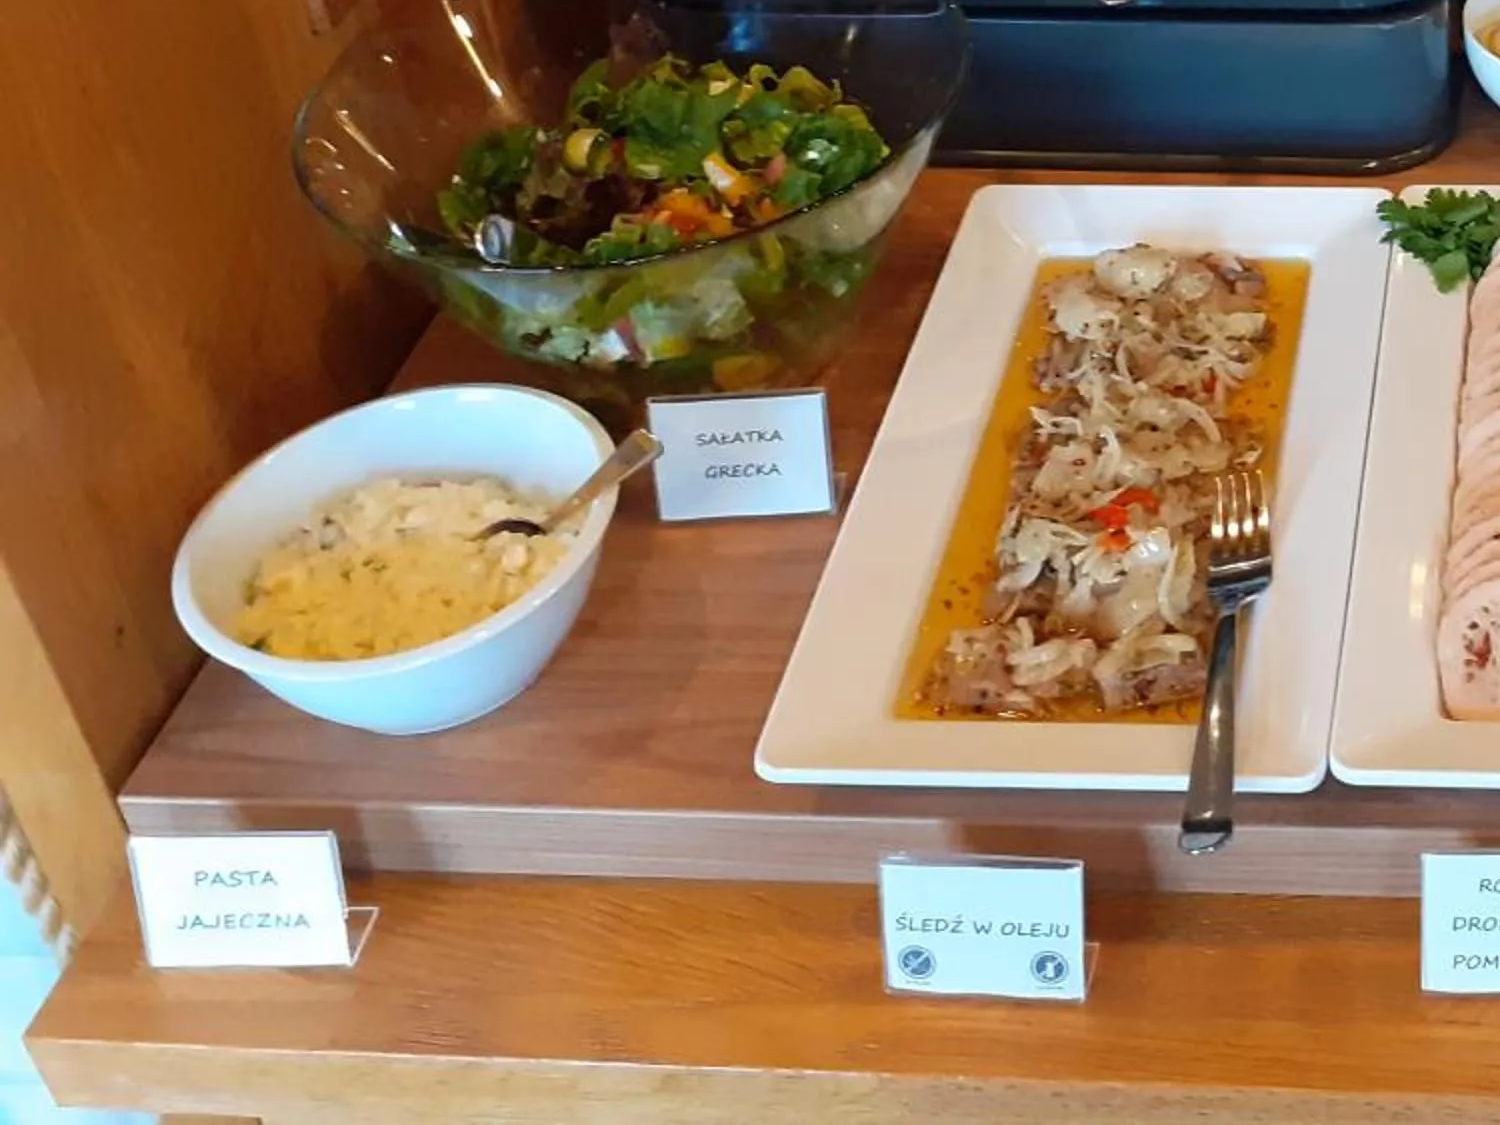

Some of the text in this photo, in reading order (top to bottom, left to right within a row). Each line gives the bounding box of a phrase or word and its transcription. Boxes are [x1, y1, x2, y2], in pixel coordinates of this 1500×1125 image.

[696, 430, 784, 447] SAŁATKA
[705, 463, 783, 479] GRECKA
[194, 870, 278, 887] PASTA
[177, 913, 311, 930] JAJECZNA
[895, 912, 1070, 938] ŚLEDŹ W OLEJU
